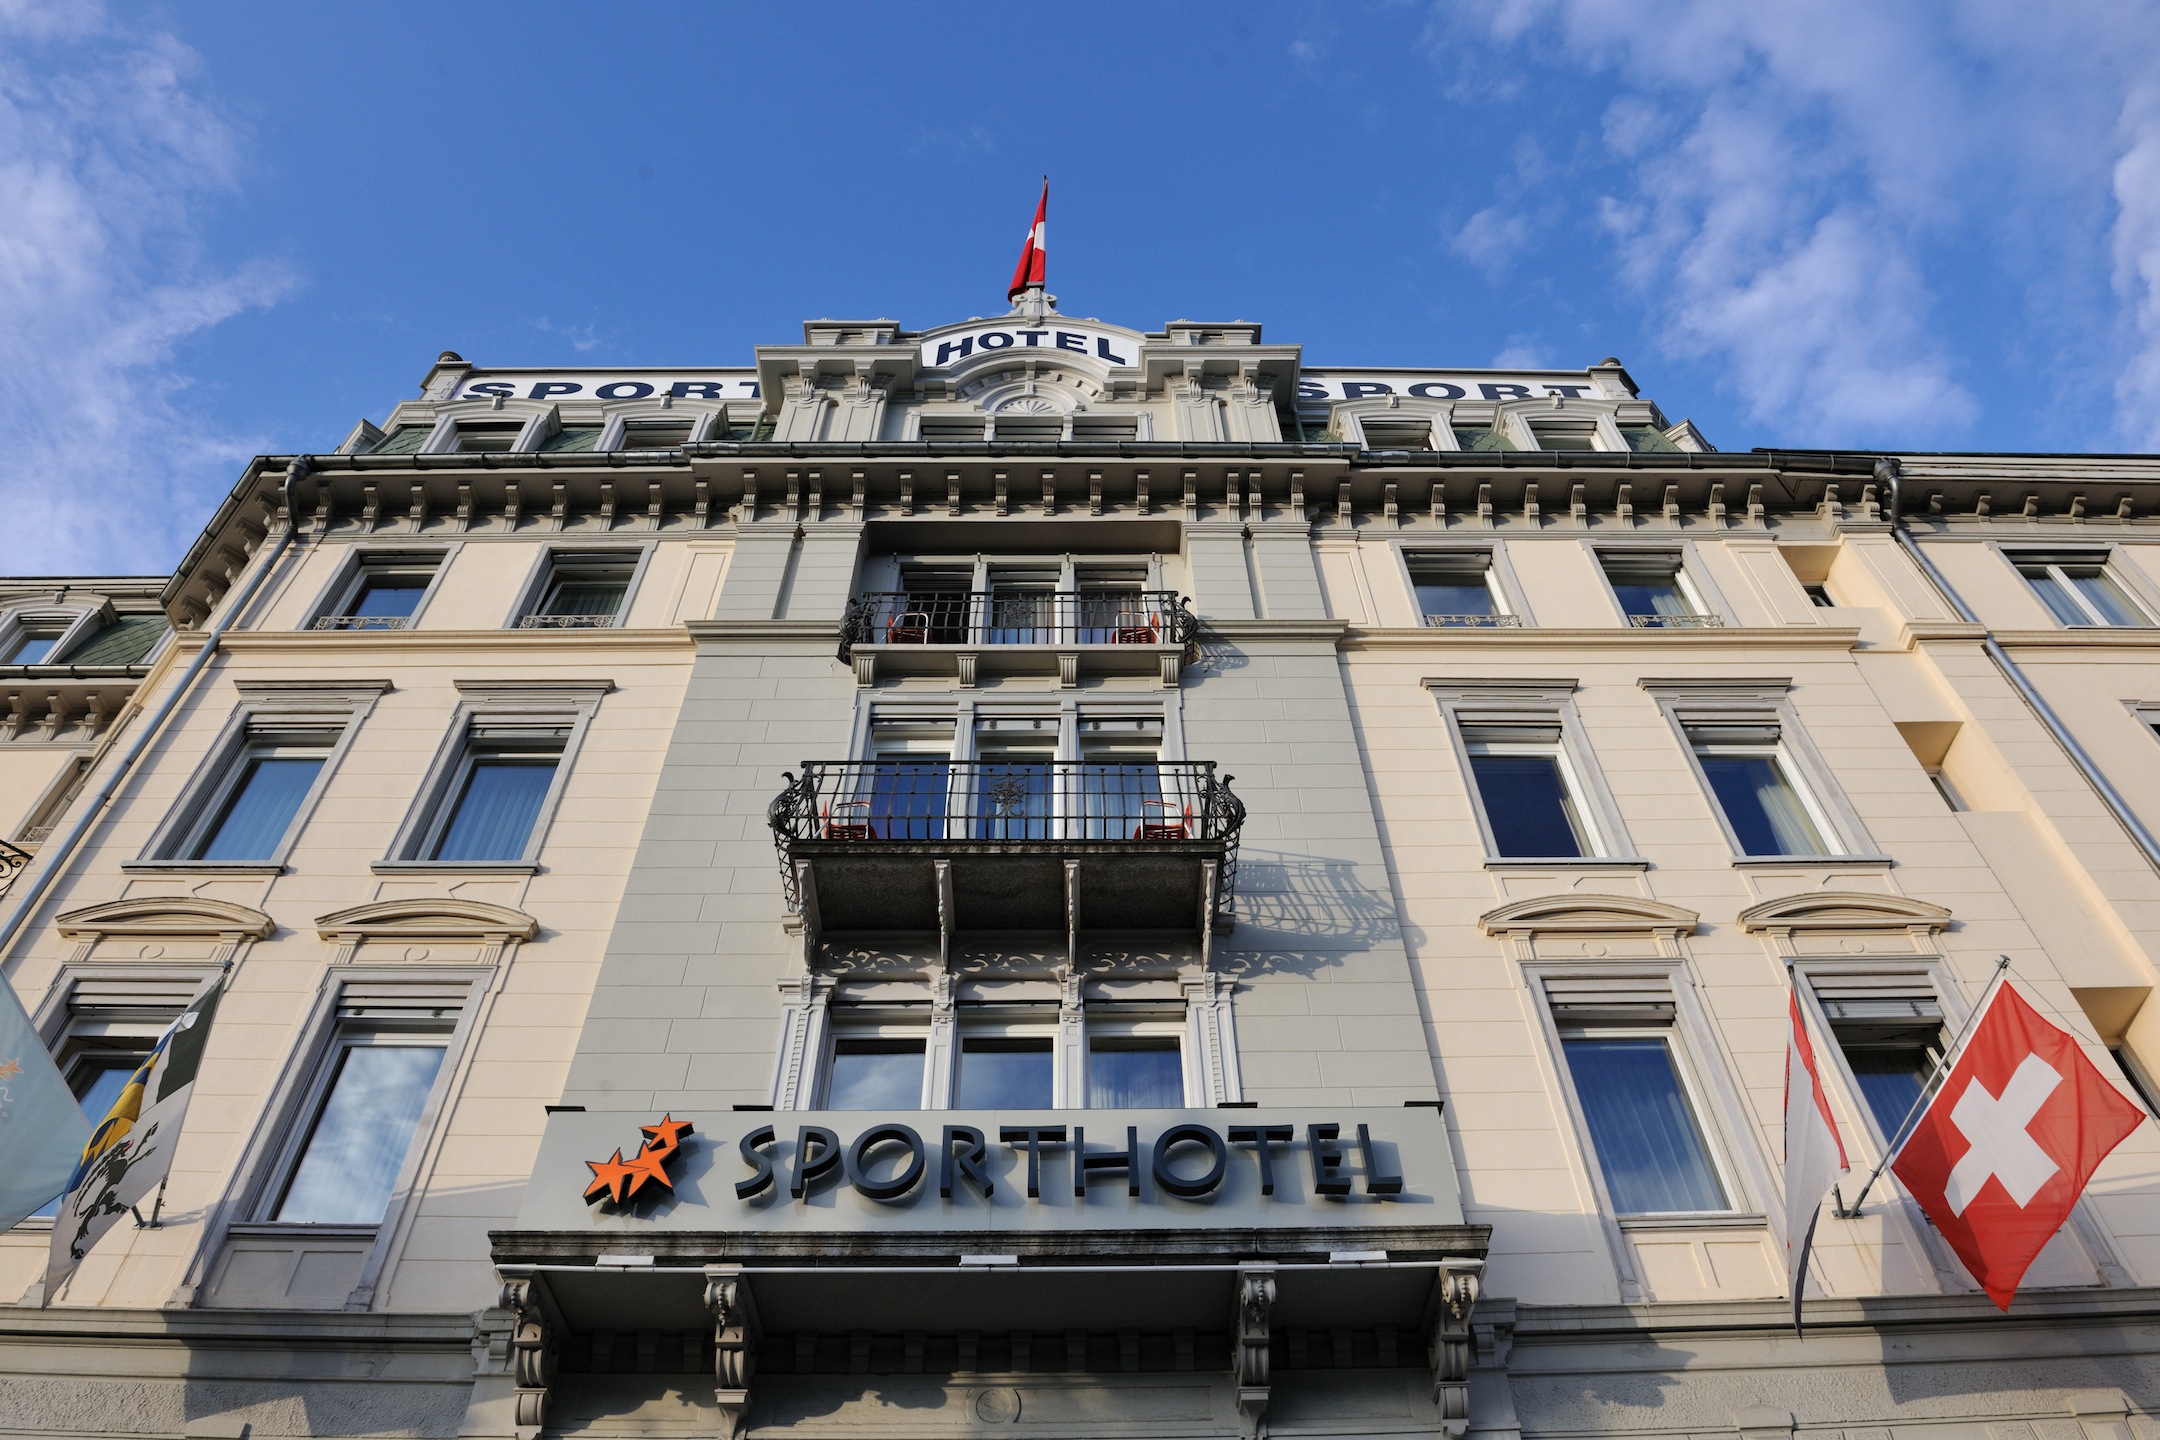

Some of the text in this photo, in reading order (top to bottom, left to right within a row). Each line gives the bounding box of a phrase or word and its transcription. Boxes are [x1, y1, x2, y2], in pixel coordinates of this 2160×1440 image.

[936, 331, 1126, 366] HOTEL
[463, 381, 760, 400] SPORT
[1299, 382, 1592, 400] SPORT
[735, 1123, 1402, 1199] SPORTHOTEL
